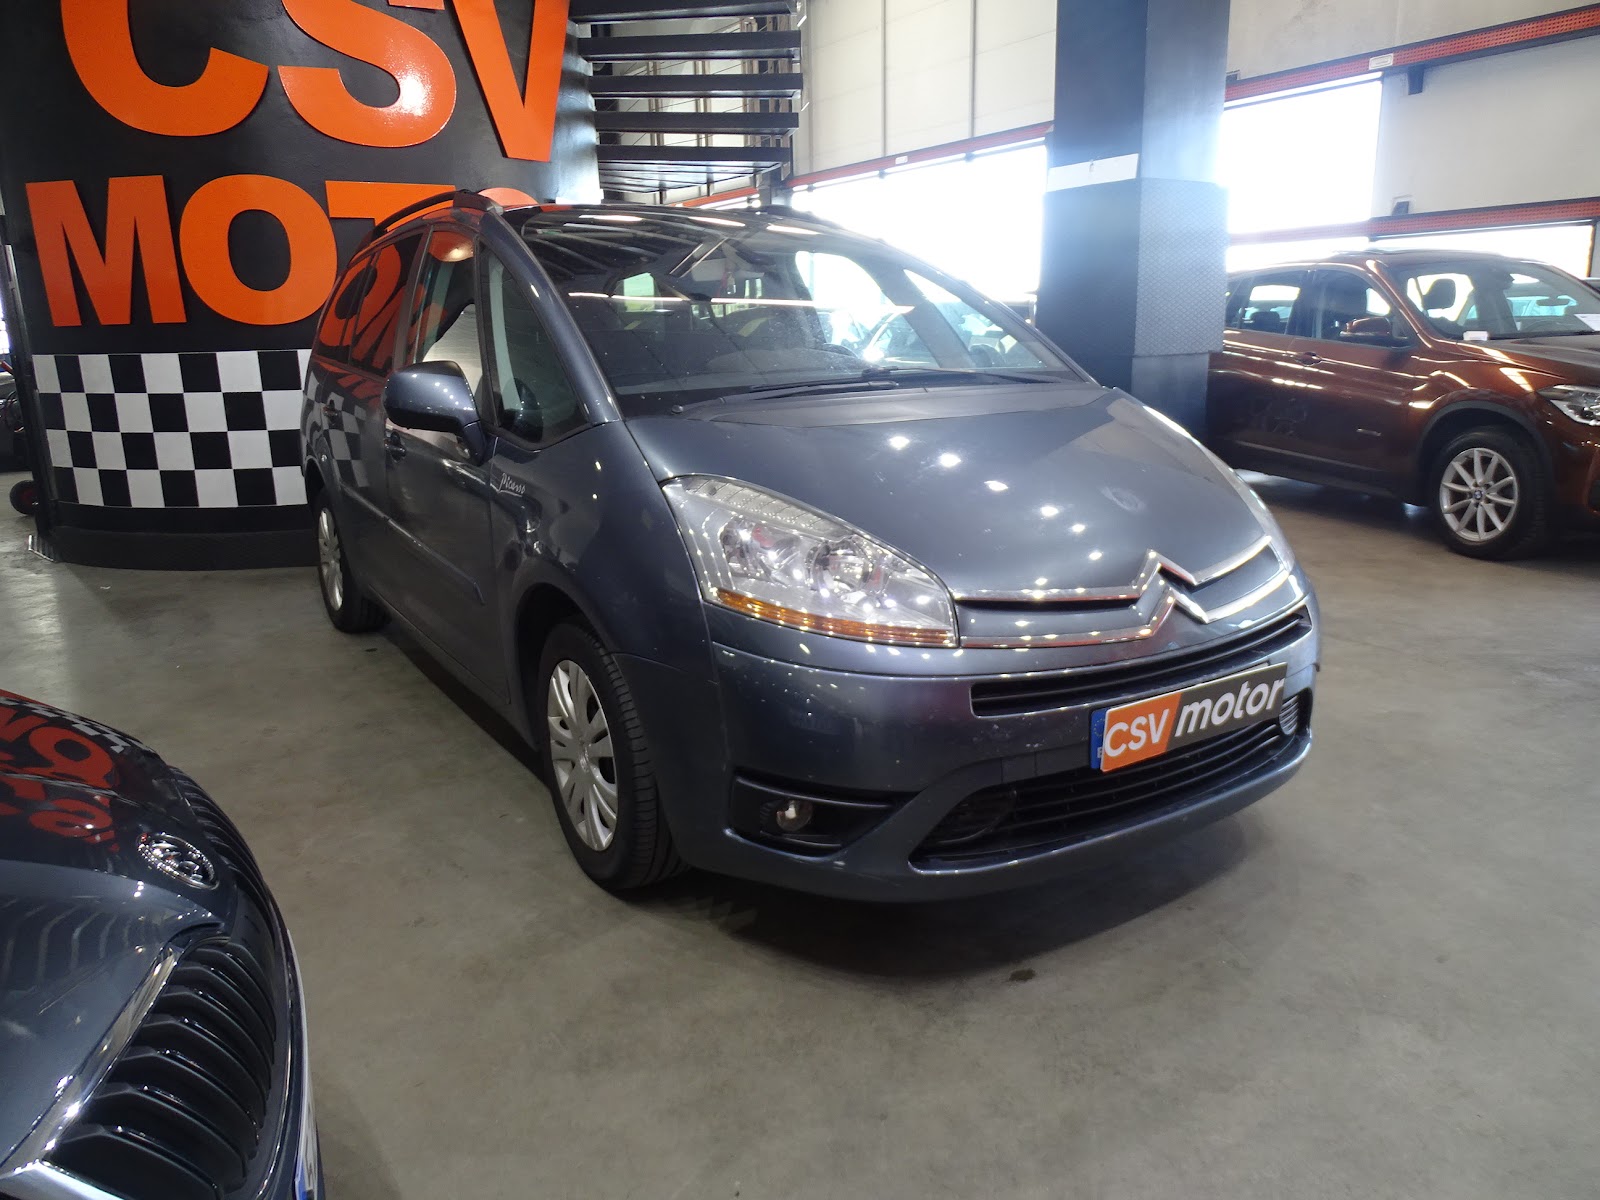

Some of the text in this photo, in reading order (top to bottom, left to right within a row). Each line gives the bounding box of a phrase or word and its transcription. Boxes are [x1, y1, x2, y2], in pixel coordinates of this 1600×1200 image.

[62, 0, 570, 162] CSV
[1104, 677, 1286, 758] CSV motor
